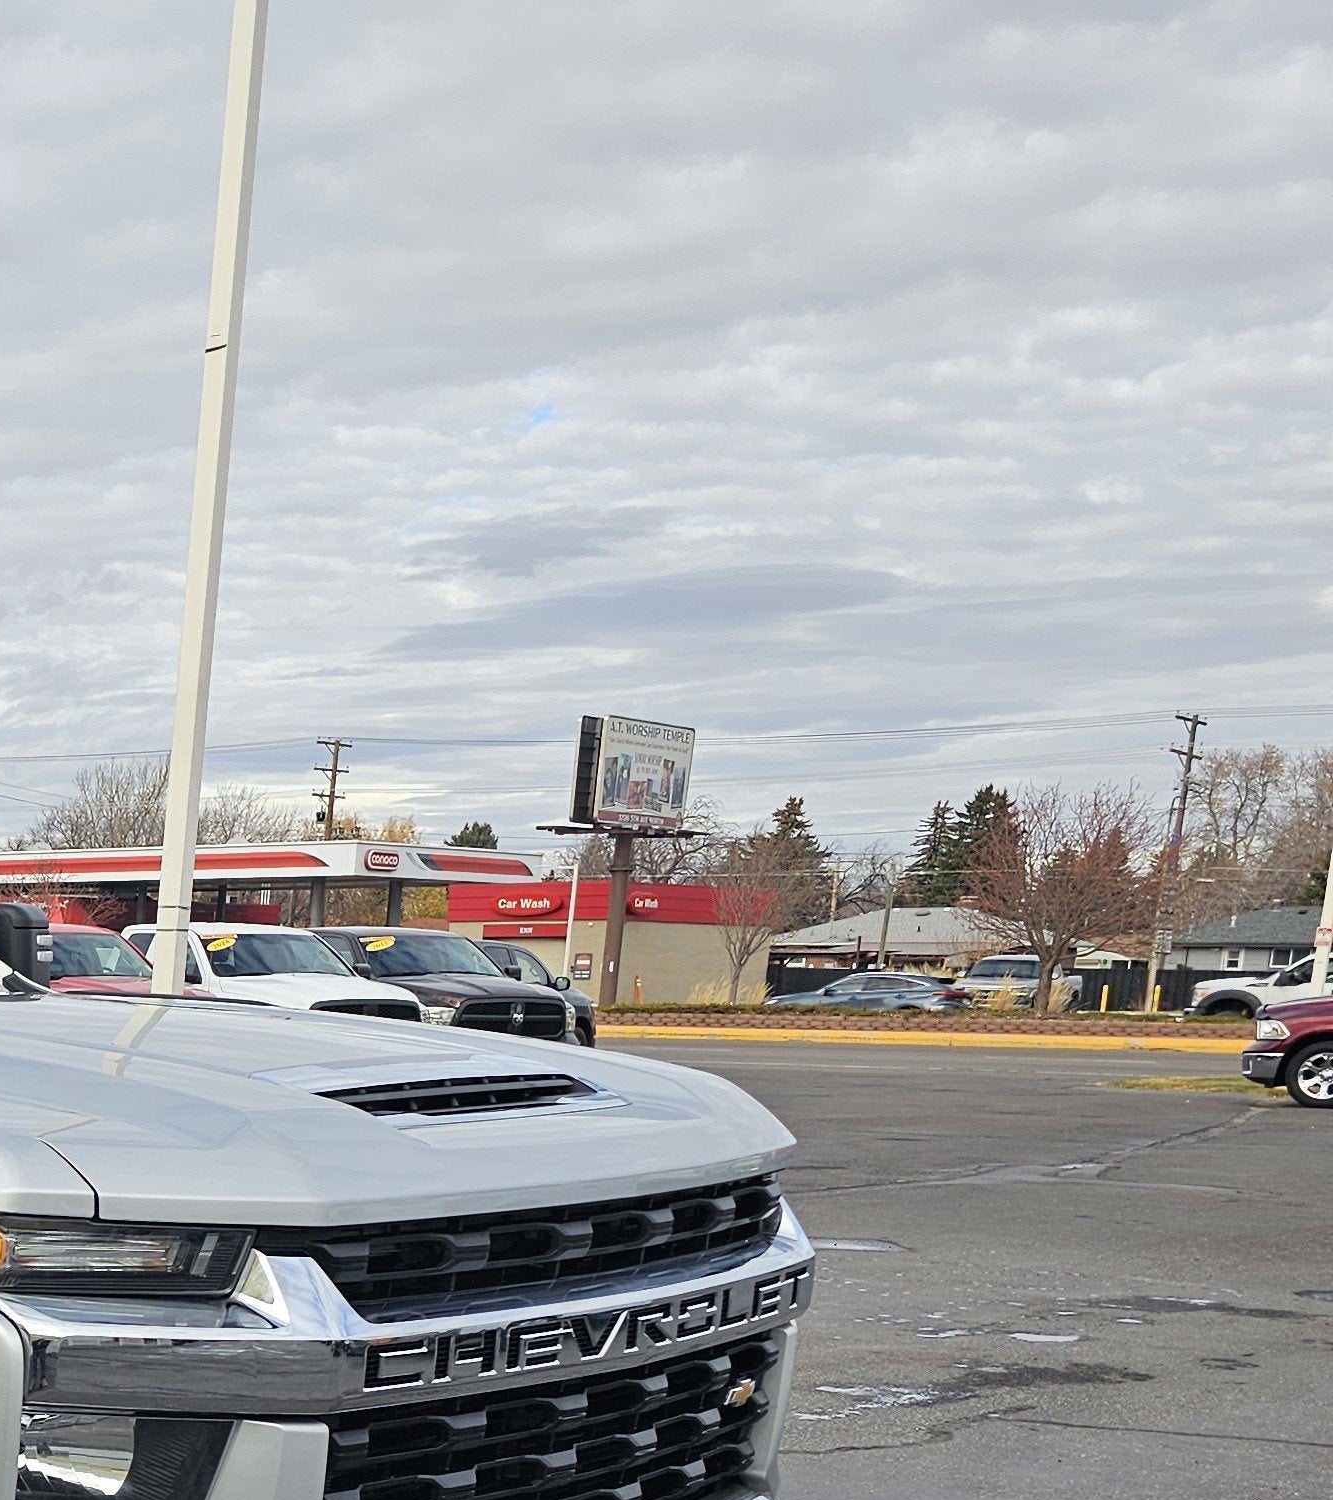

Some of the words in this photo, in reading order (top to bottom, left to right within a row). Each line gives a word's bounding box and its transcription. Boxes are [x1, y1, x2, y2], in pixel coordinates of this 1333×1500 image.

[626, 723, 661, 739] WORSHIP
[662, 728, 691, 744] TEMPLE
[498, 898, 517, 909] Car
[520, 898, 550, 909] Wash
[634, 897, 644, 908] Car
[363, 1266, 810, 1393] CHEVROLET
